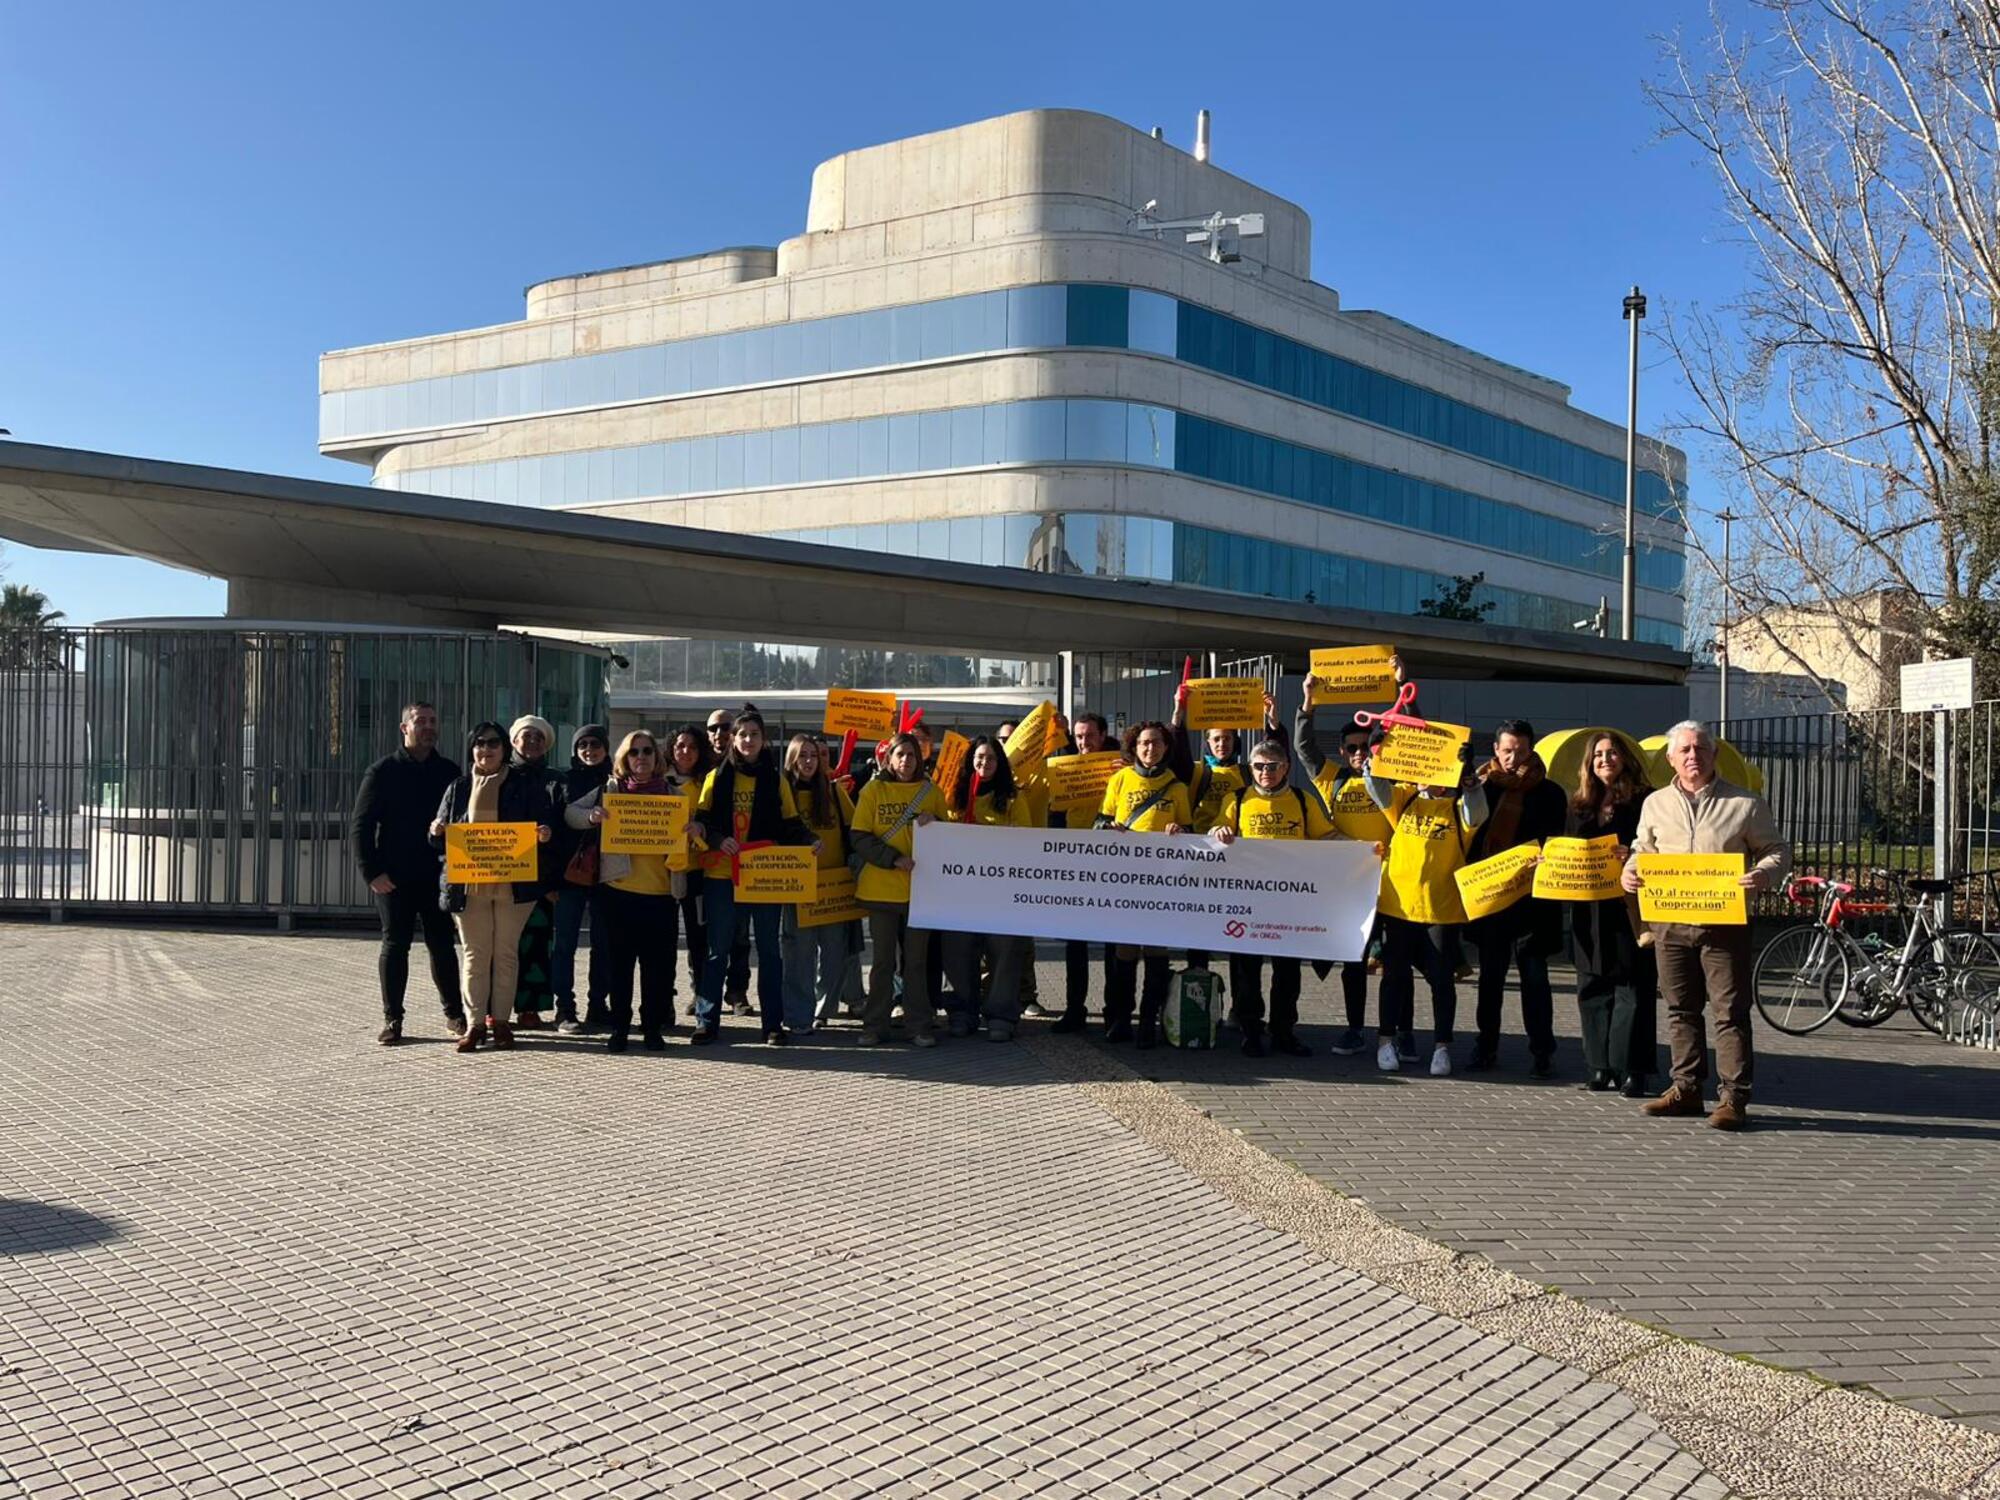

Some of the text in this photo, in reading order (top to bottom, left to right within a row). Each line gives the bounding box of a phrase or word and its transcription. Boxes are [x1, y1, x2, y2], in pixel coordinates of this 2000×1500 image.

[1249, 812, 1283, 826] STOP
[1043, 841, 1226, 863] DIPUTACIÓN DE GRANADA
[942, 864, 1318, 894] NO A LOS RECORTES EN COOPERACIÓN INTERNACIONAL
[1642, 868, 1679, 876] Granada
[1644, 887, 1736, 898] ¡NO al recorte en
[1014, 893, 1252, 915] SOLUCIONES A LA CONVOCATORIA DE 2024
[1654, 899, 1726, 910] Cooperación!
